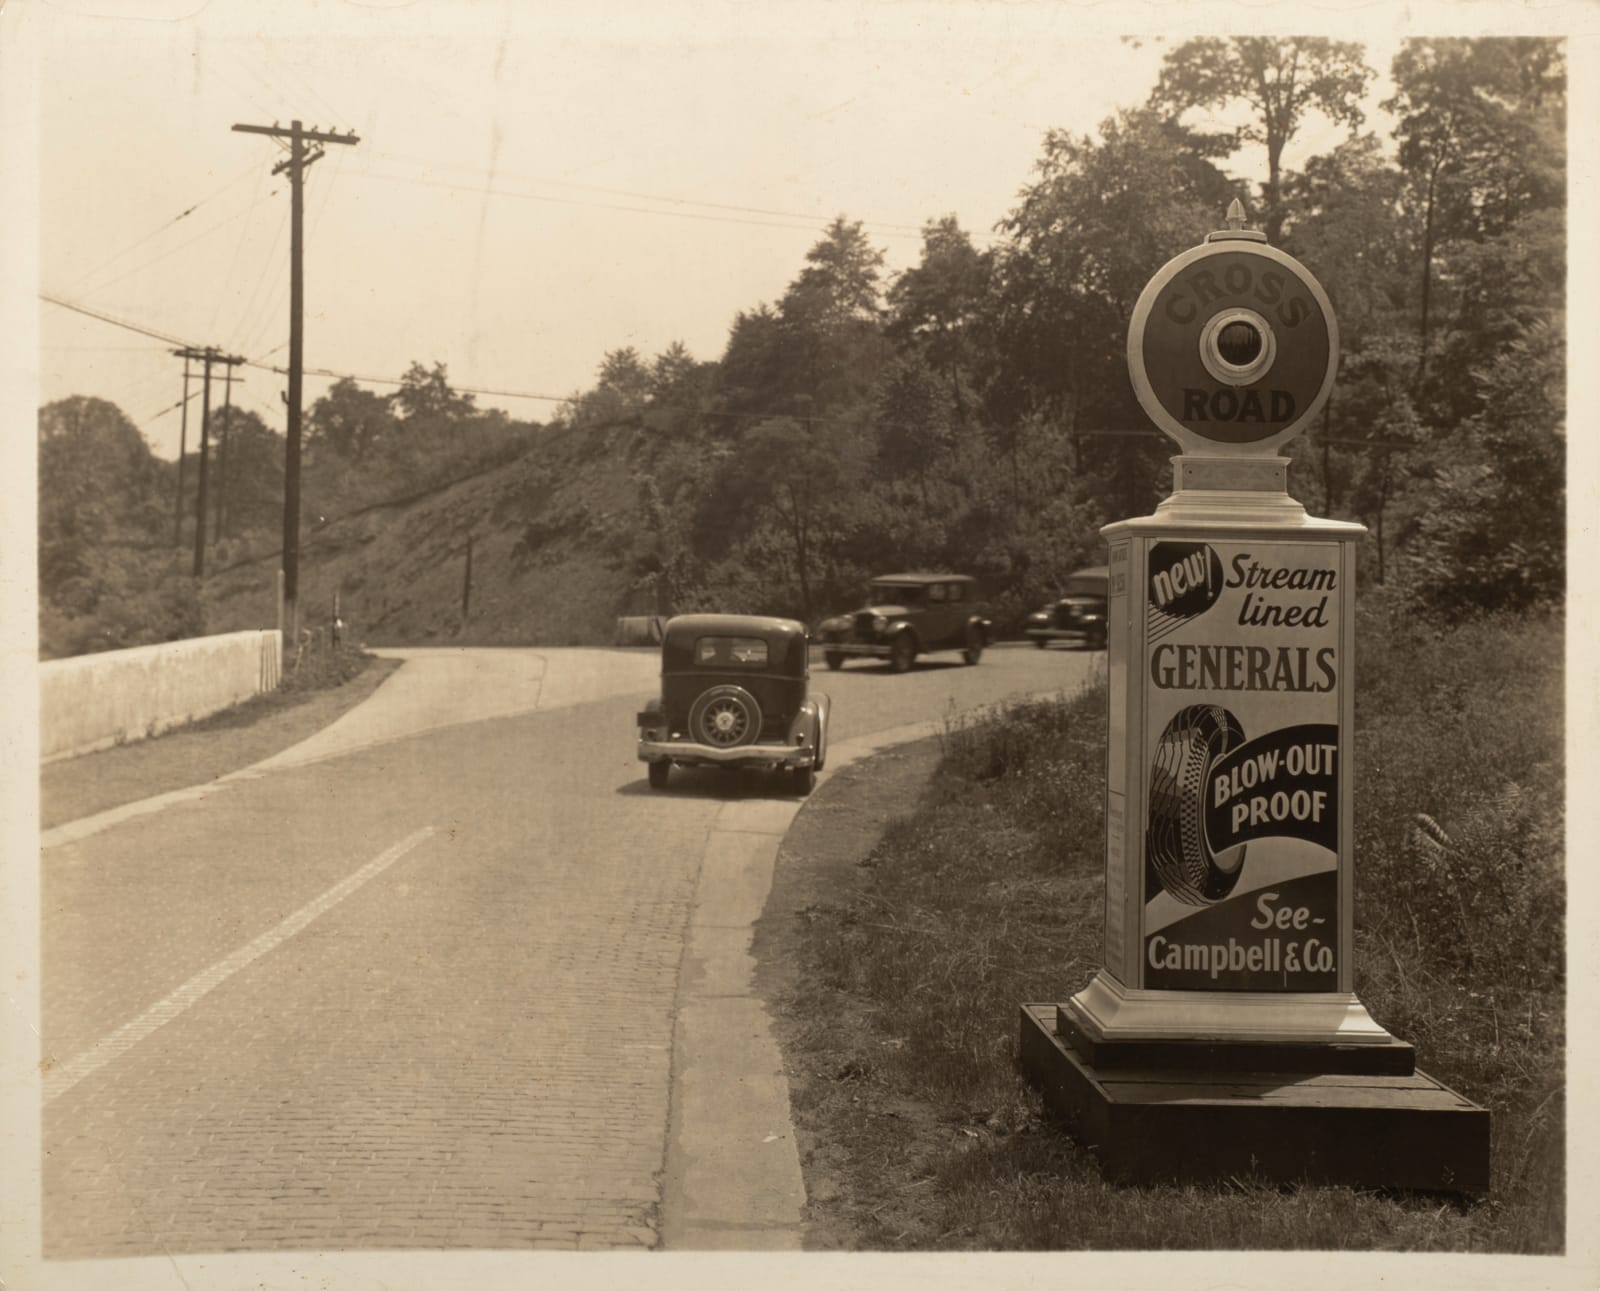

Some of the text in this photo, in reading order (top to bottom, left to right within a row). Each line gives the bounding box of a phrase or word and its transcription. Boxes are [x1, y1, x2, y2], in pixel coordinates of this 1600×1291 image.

[1165, 263, 1311, 328] CROSS
[1183, 388, 1296, 423] ROAD
[1153, 543, 1214, 607] new!
[1225, 554, 1337, 591] Stream
[1238, 593, 1328, 628] lined
[1151, 644, 1337, 693] GENERALS
[1214, 744, 1337, 808] BLOW-OUT
[1232, 790, 1327, 834] PROOF
[1149, 936, 1280, 980] Campbell
